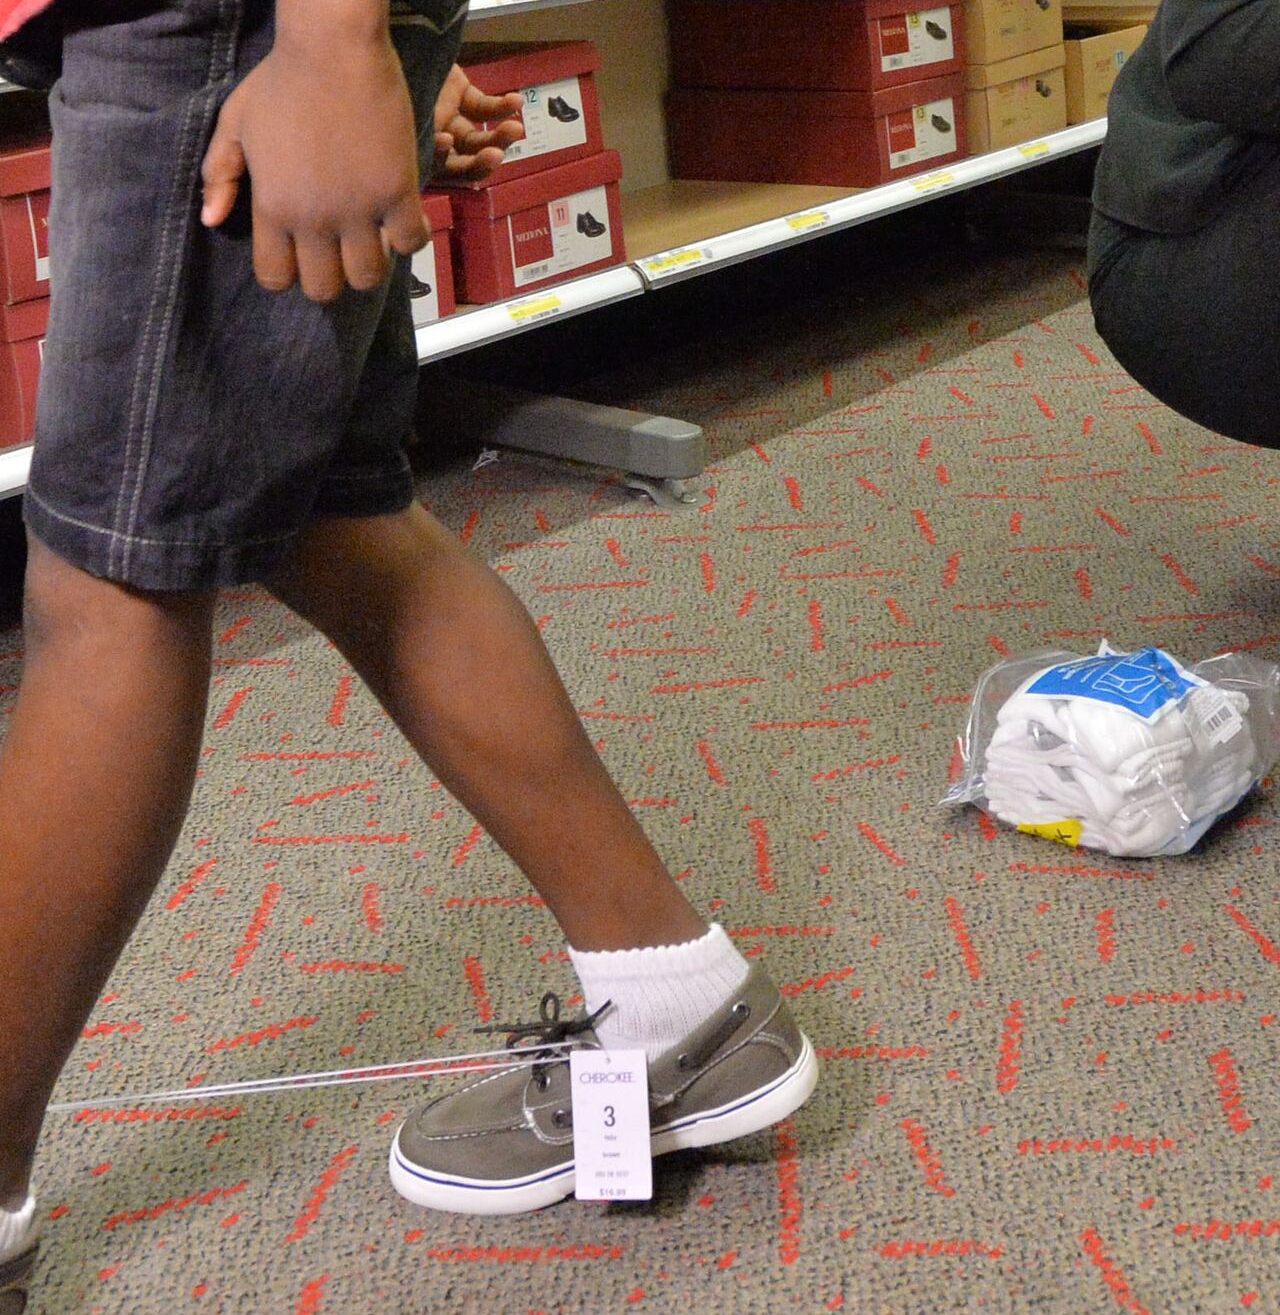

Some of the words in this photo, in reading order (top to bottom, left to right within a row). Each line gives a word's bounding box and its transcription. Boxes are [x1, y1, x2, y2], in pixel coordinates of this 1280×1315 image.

[524, 89, 537, 104] 12
[580, 1071, 633, 1084] CHEROKEE
[603, 1106, 616, 1127] 3
